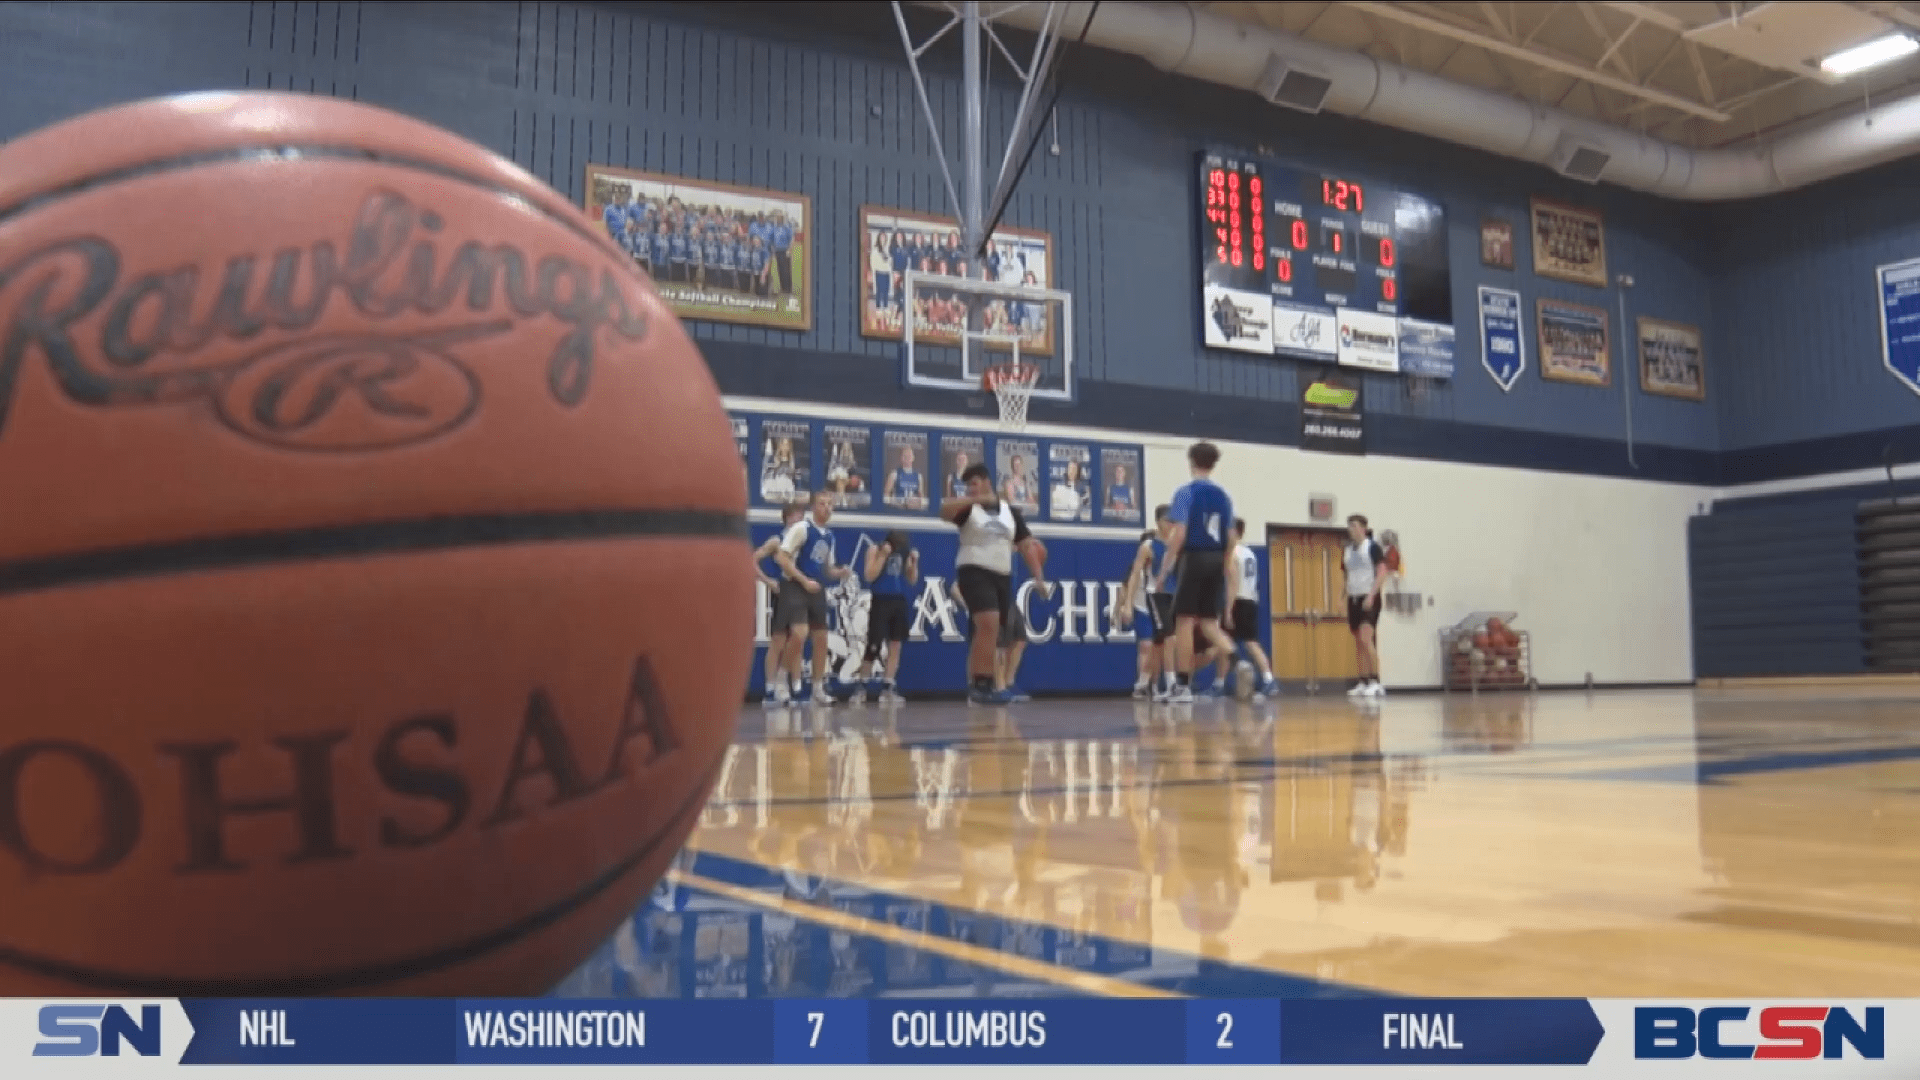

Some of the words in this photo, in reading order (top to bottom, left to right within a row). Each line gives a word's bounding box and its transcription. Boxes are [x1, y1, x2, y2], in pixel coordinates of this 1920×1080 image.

[1209, 169, 1225, 187] 10
[1228, 172, 1239, 190] 0
[1250, 177, 1261, 195] 0
[1229, 191, 1240, 209] 0
[1251, 196, 1262, 214] 0
[1322, 179, 1363, 212] 1:27
[1230, 210, 1241, 228] 0
[1252, 215, 1263, 233] 0
[1230, 229, 1242, 247] 0
[1253, 233, 1264, 252] 0
[1292, 220, 1308, 250] 0
[1333, 233, 1341, 254] 1
[1231, 247, 1242, 267] 0
[1254, 252, 1265, 271] 0
[1380, 238, 1395, 267] 0
[1278, 259, 1292, 282] 0
[1382, 278, 1396, 300] 0
[0, 188, 648, 438] Rawlings
[0, 653, 682, 875] OHSAA
